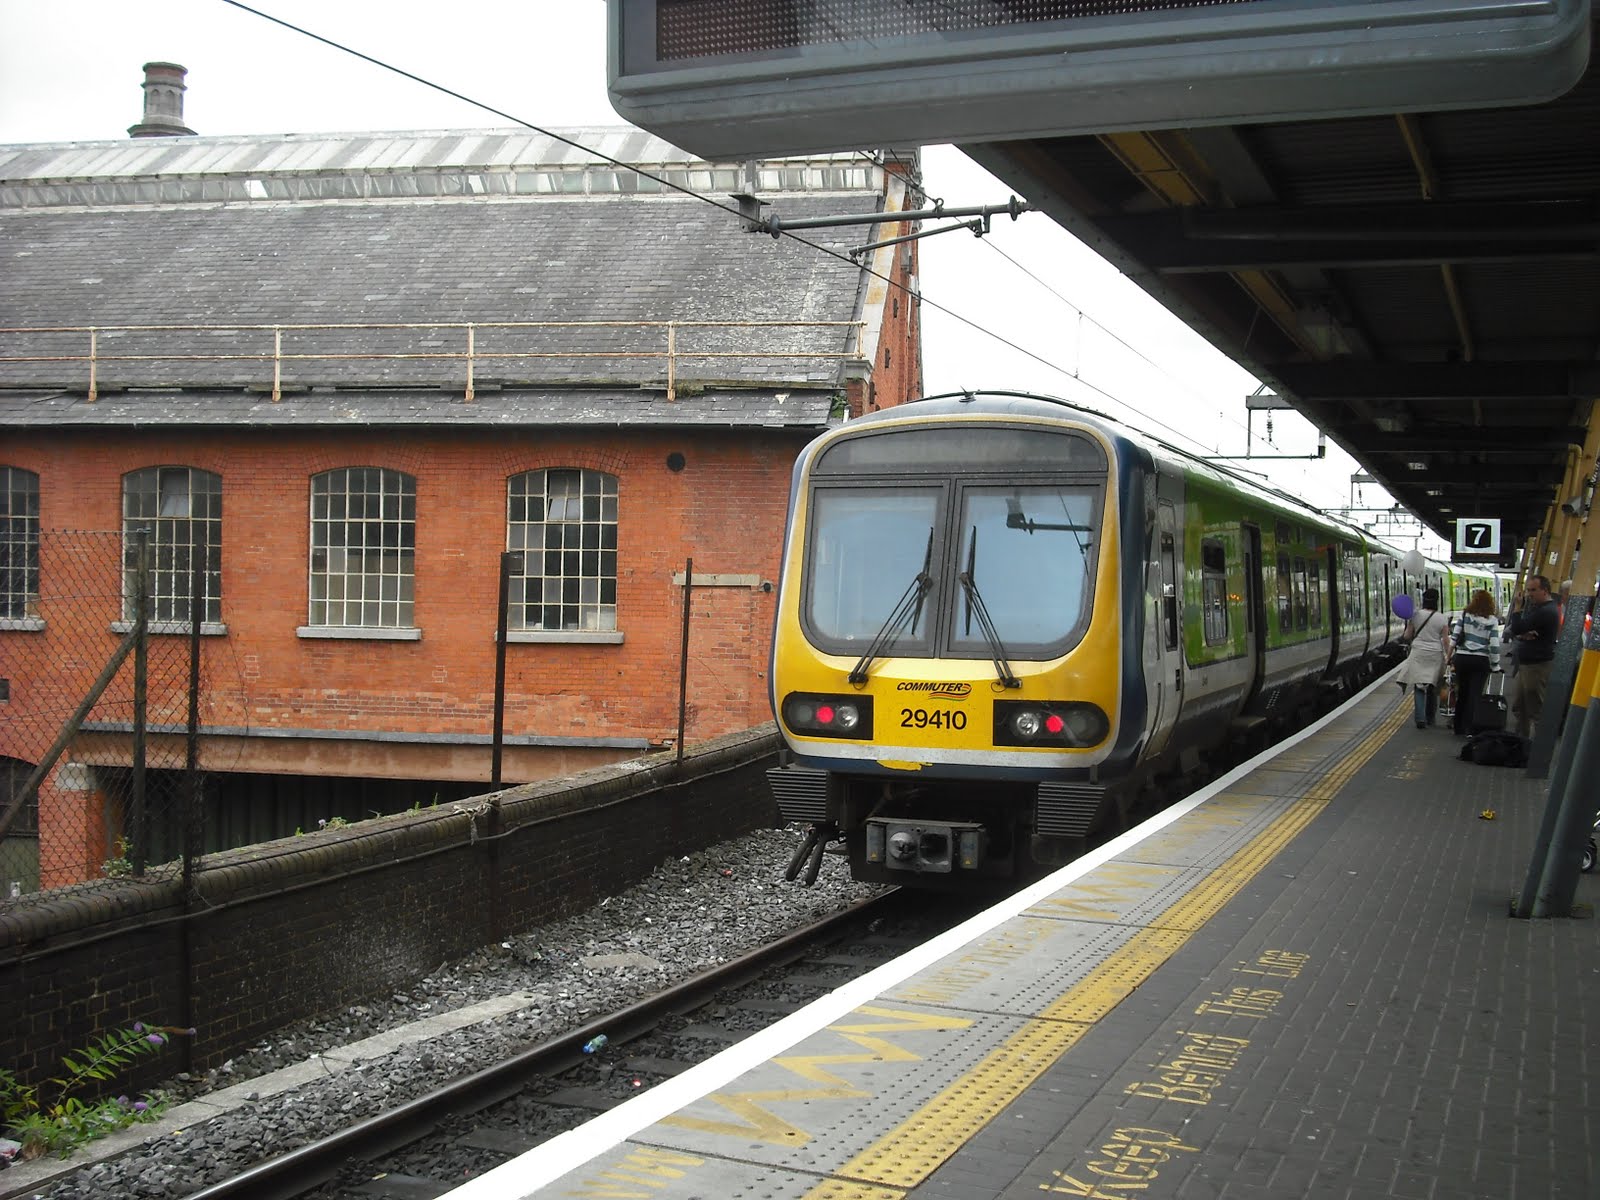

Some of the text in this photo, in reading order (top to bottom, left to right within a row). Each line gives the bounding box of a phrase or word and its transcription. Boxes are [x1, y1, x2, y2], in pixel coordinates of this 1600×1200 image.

[1471, 527, 1486, 545] 7
[896, 682, 964, 692] COMMUTER
[900, 708, 967, 730] 29410
[1039, 950, 1310, 1200] Keep Behind This Line
